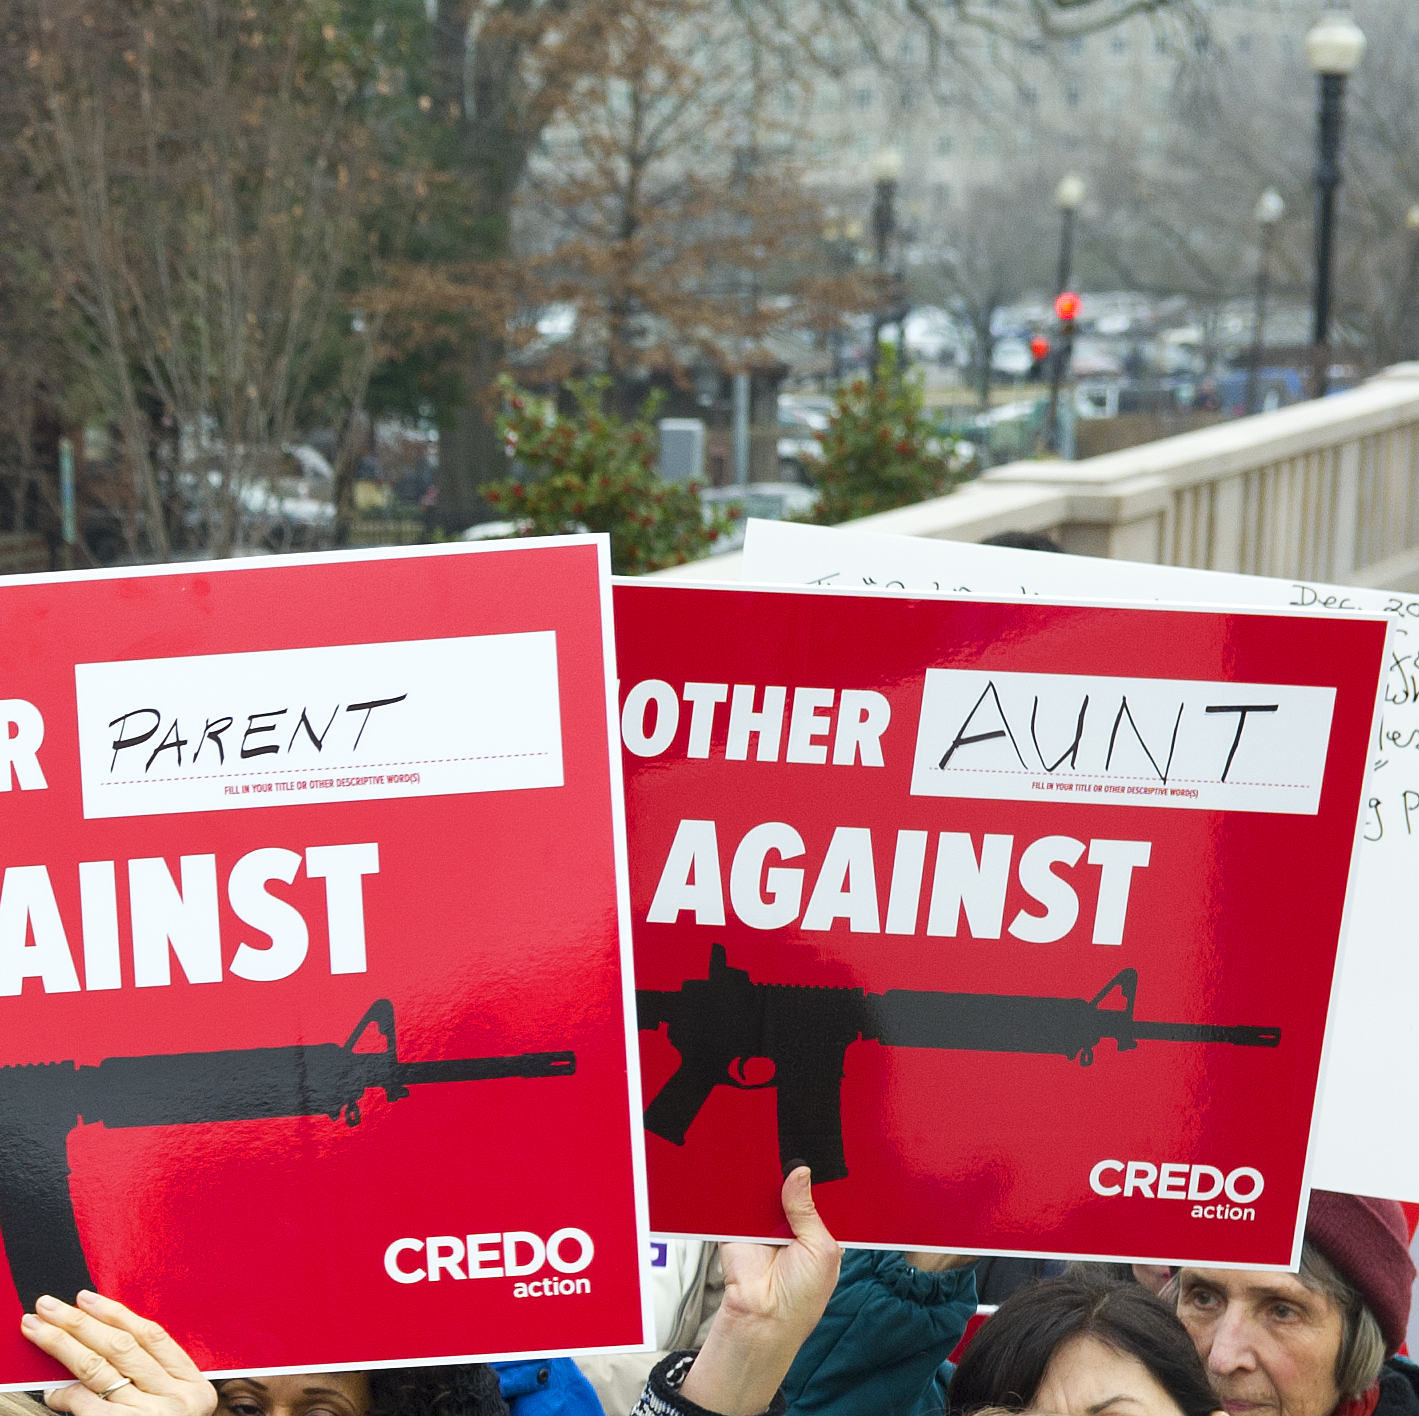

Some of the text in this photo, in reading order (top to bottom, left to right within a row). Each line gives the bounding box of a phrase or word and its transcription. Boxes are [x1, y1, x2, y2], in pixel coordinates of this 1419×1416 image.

[109, 694, 407, 773] PARENT
[621, 679, 892, 768] OTHER
[940, 682, 1278, 785] AUNT
[224, 773, 420, 795] FILL IN YOUR TITLE OR OTHER DESCRIPTIVE WORD(S)
[1032, 782, 1044, 790] FILL
[1056, 783, 1073, 791] YOUR
[1075, 783, 1092, 792] TITLE
[1093, 784, 1103, 792] OR
[1104, 785, 1125, 793] OTHER
[1127, 786, 1168, 796] DESCRIPTIVE
[1170, 788, 1198, 799] WORD(S)
[647, 820, 1152, 945] AGAINST
[1090, 1160, 1265, 1204] CREDO
[1190, 1200, 1257, 1222] action
[384, 1228, 595, 1284] CREDO
[513, 1276, 591, 1298] action
